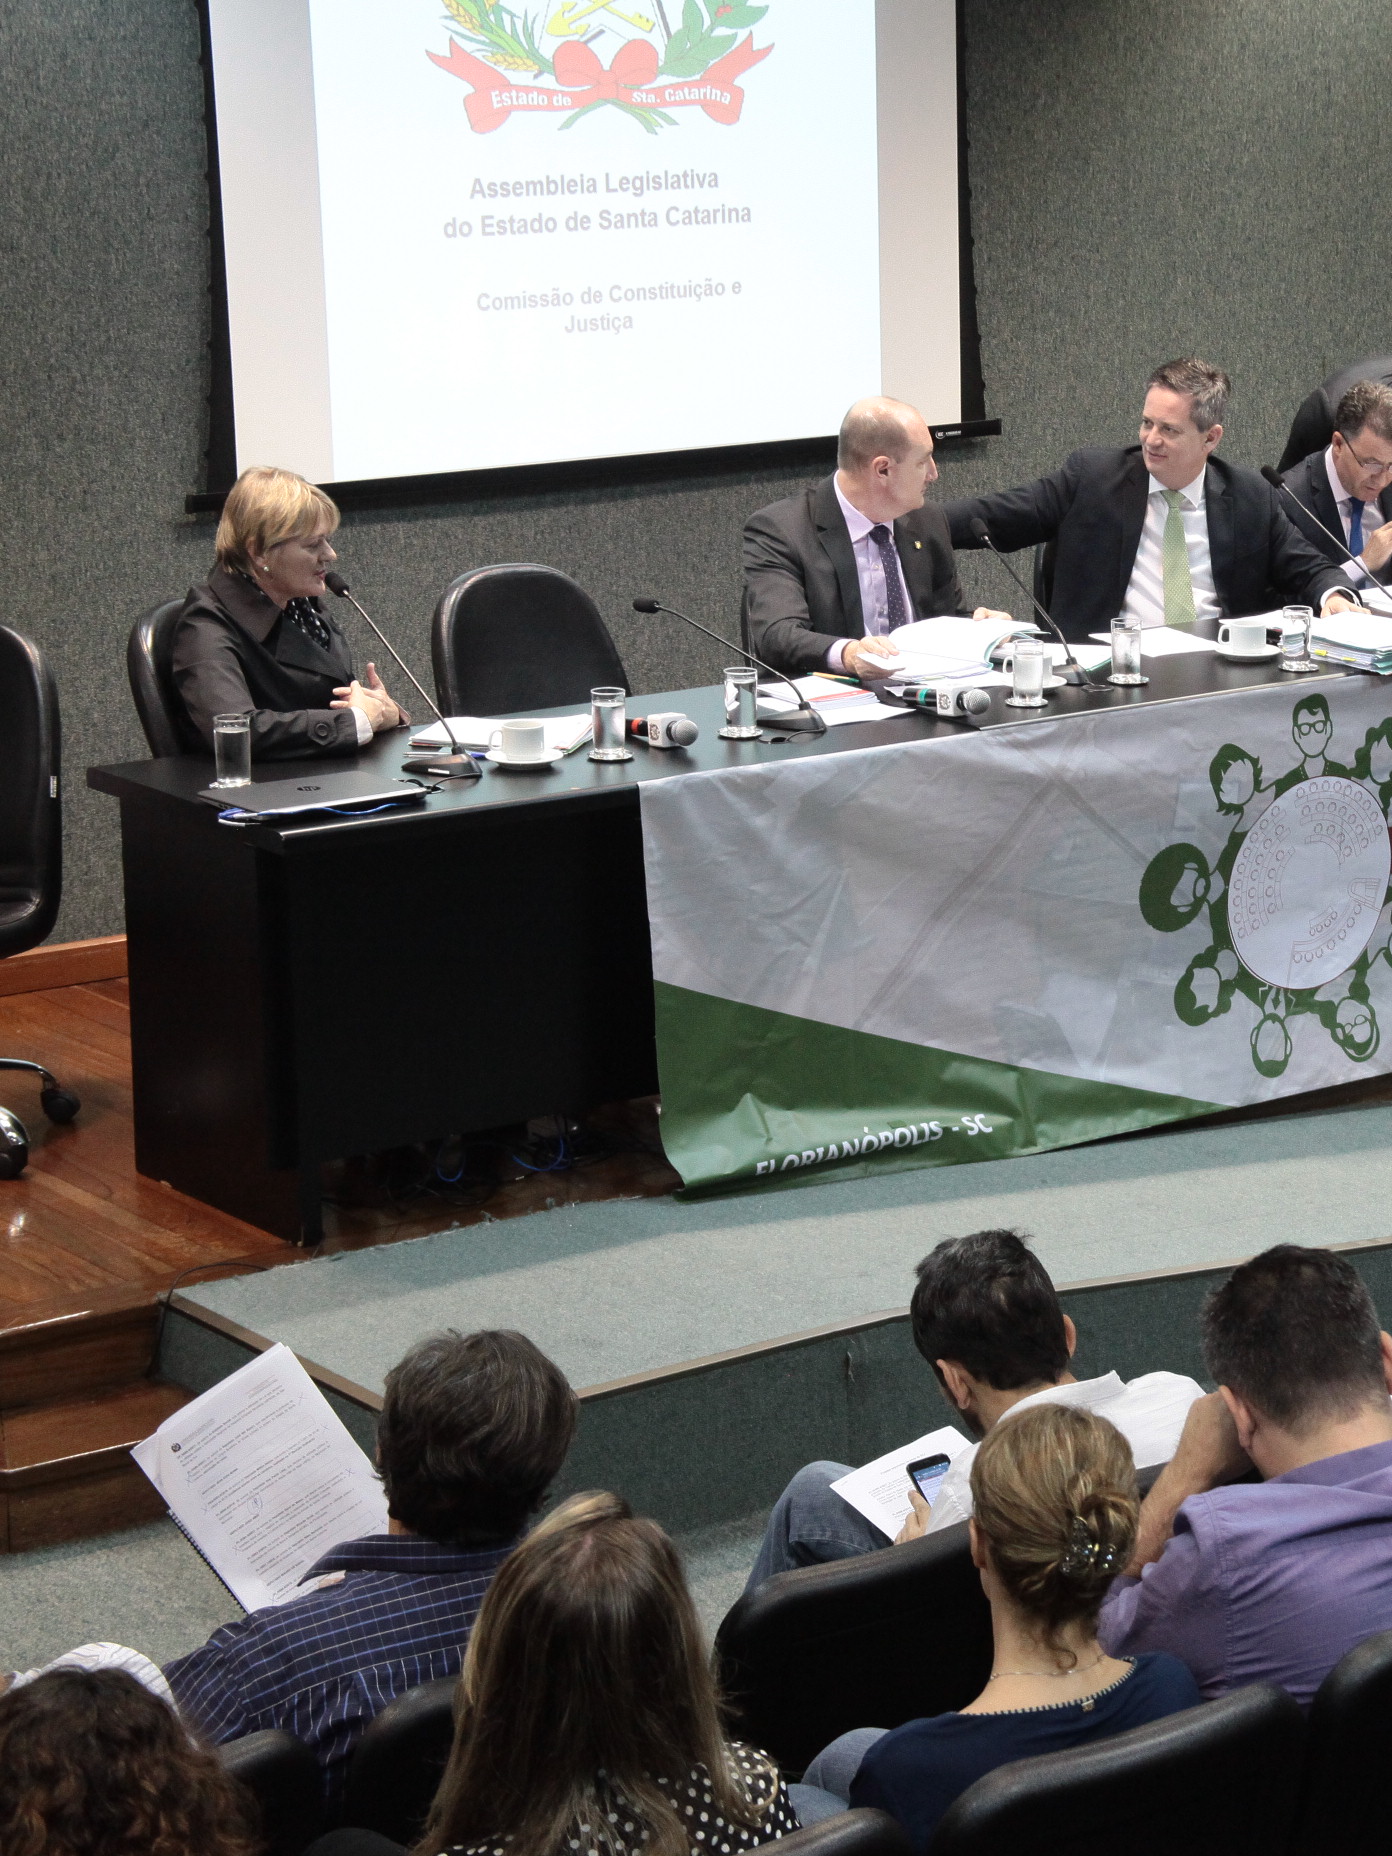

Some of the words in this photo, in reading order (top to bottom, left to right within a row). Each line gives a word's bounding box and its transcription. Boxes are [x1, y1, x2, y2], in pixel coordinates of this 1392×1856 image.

[490, 88, 548, 109] Estado
[552, 92, 572, 106] de
[631, 90, 660, 104] Sta.
[664, 85, 732, 105] Catarina
[469, 174, 597, 200] Assembleia
[604, 169, 719, 198] Legislativa
[443, 217, 472, 239] do
[481, 212, 558, 237] Estado
[564, 210, 591, 233] de
[598, 207, 659, 230] Santa
[665, 203, 752, 227] Catarina
[476, 287, 574, 313] Comissão
[580, 286, 603, 305] de
[608, 277, 727, 304] Constituição
[731, 280, 742, 295] e
[564, 314, 634, 336] Justiça
[961, 1113, 993, 1136] SC
